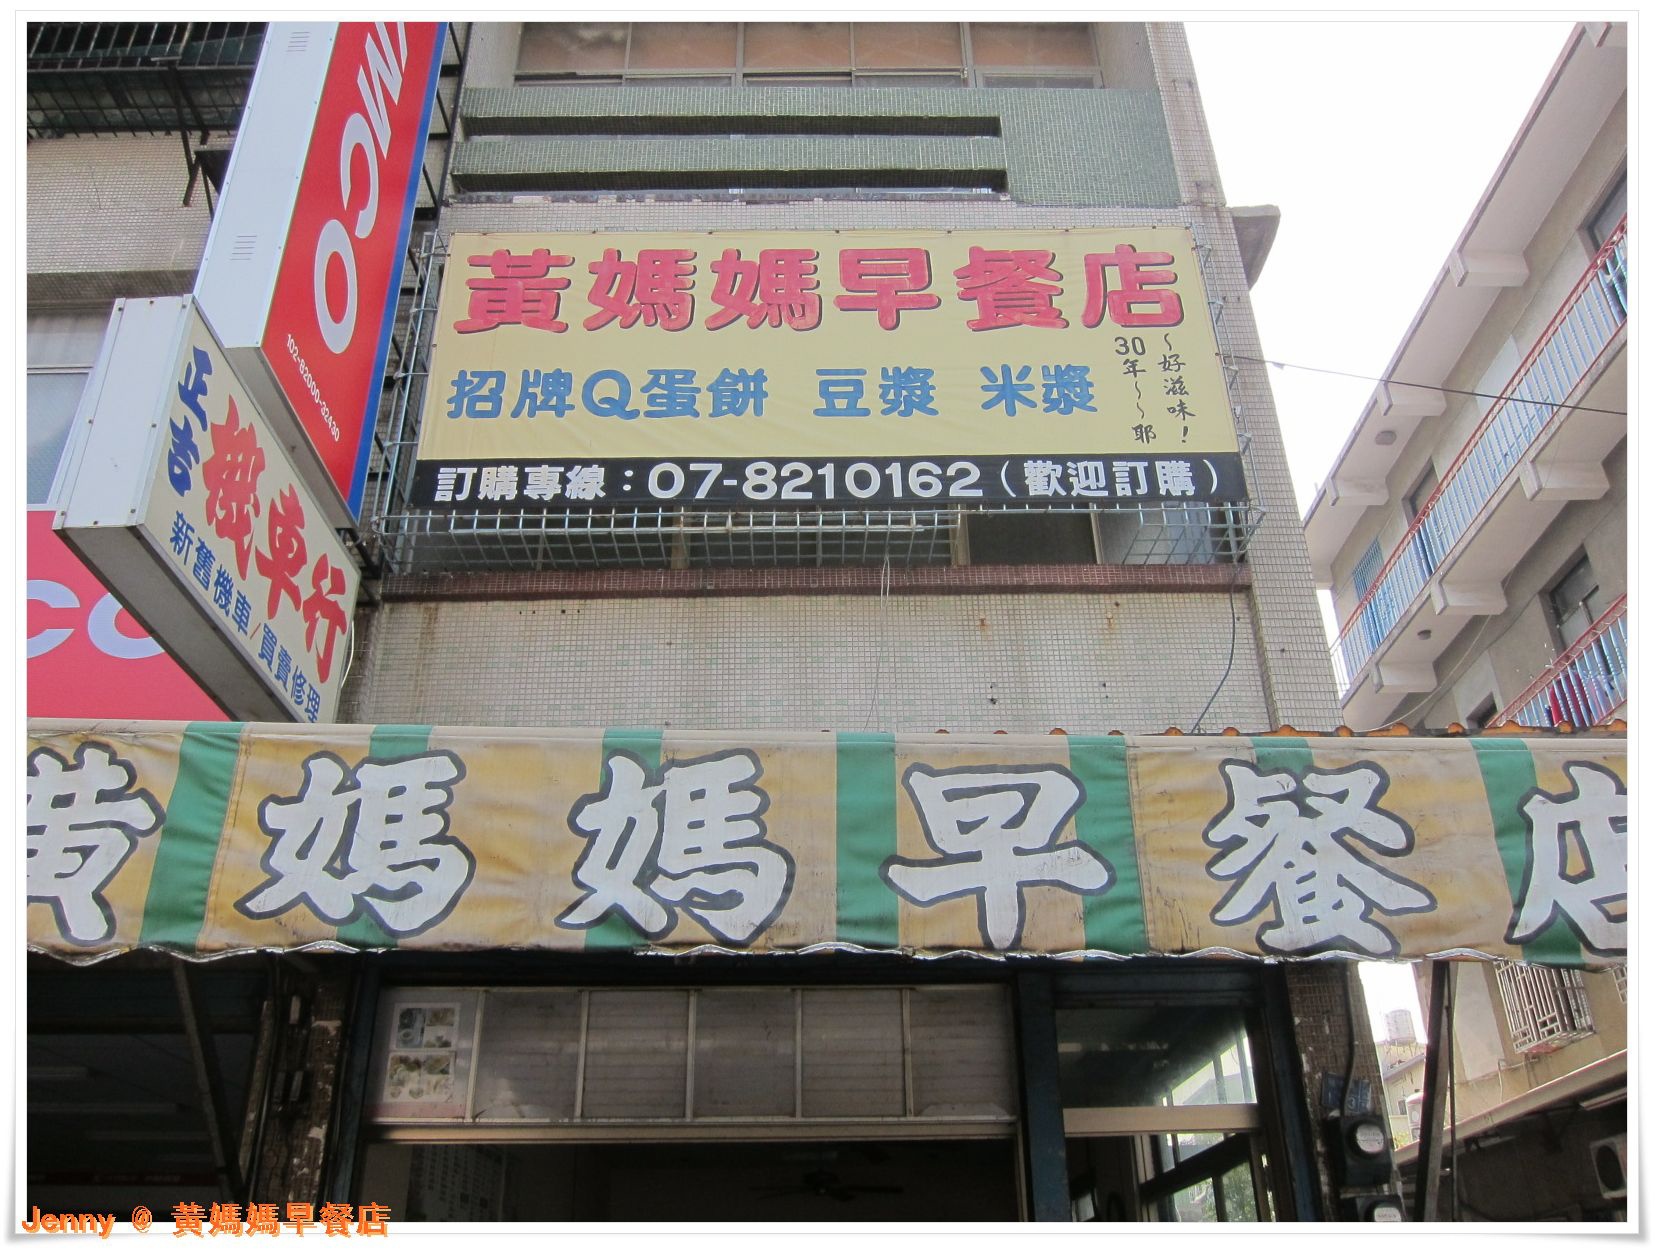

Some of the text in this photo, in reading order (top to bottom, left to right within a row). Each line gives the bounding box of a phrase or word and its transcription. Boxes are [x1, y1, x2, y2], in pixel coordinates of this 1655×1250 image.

[453, 244, 1184, 334] 黃媽媽早餐店
[446, 363, 1099, 420] 招牌Q蛋餅 豆漿 米漿
